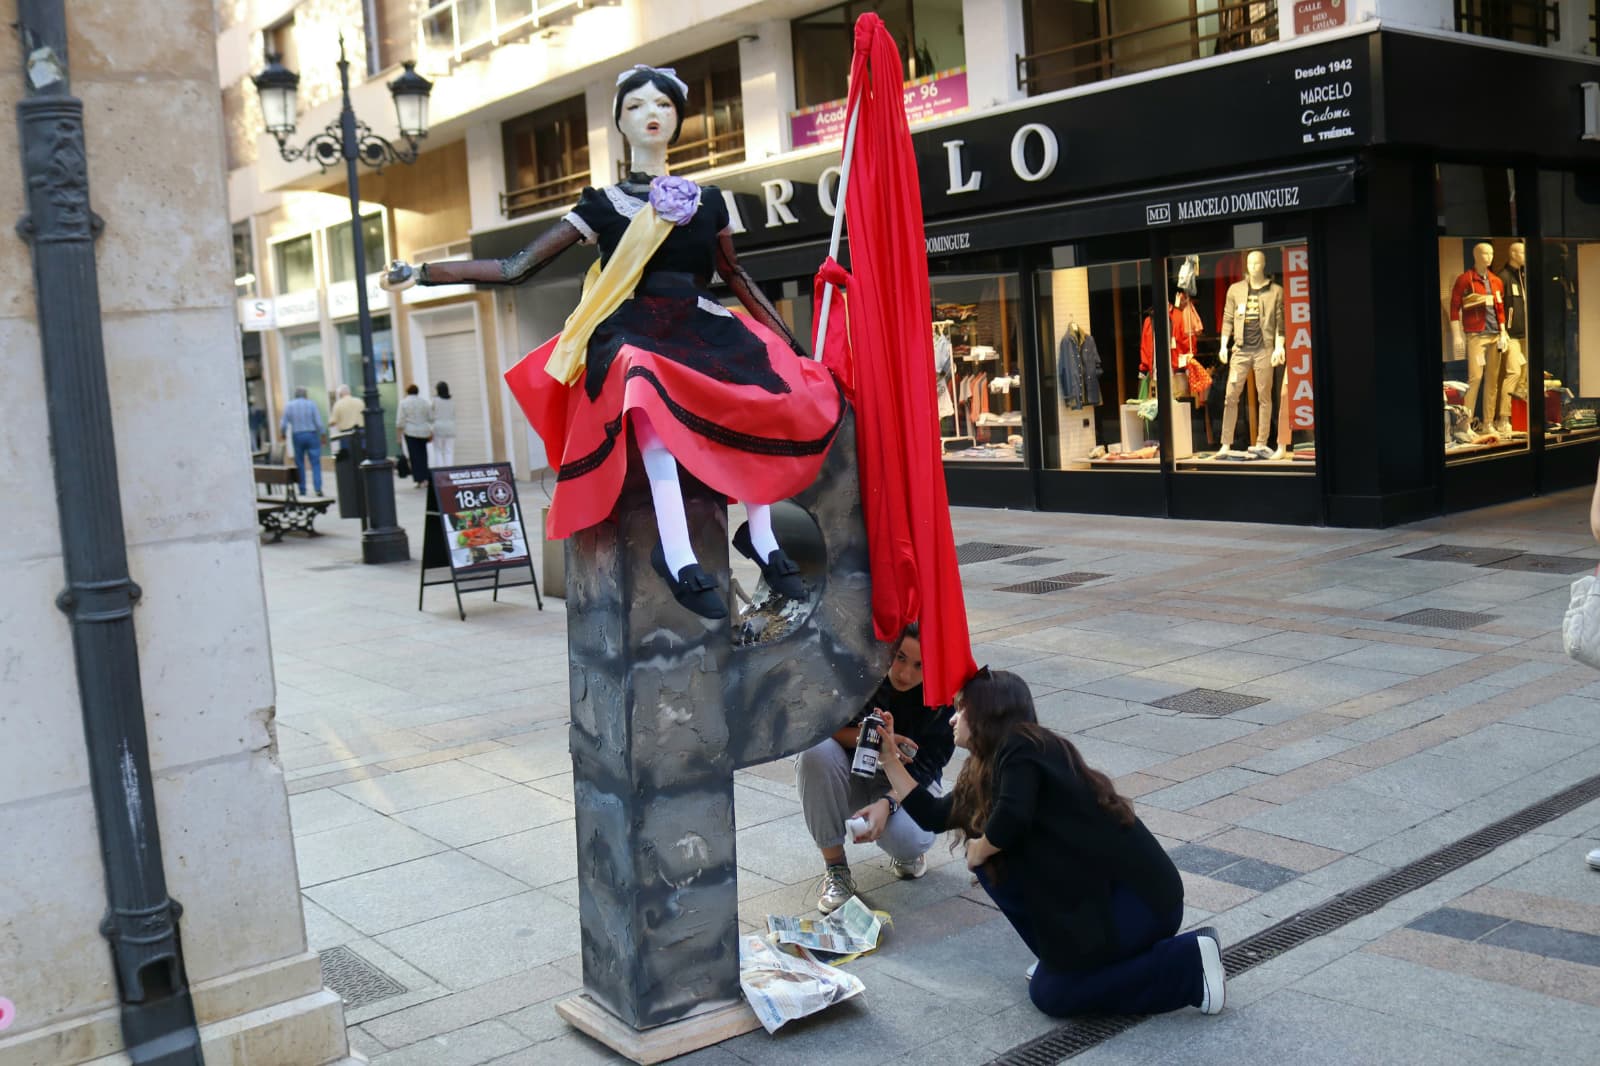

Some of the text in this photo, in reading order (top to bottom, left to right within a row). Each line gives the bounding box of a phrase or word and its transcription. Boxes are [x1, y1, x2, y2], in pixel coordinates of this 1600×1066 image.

[1298, 1, 1322, 13] CALLE
[1294, 58, 1352, 80] Desde 1942
[815, 106, 848, 126] Acad
[920, 82, 938, 101] 96
[1300, 81, 1352, 106] MARCELO
[1303, 133, 1315, 143] EL
[1149, 186, 1300, 221] MD MARCELO DOMINGUEZ
[1287, 250, 1315, 427] REBAJAS
